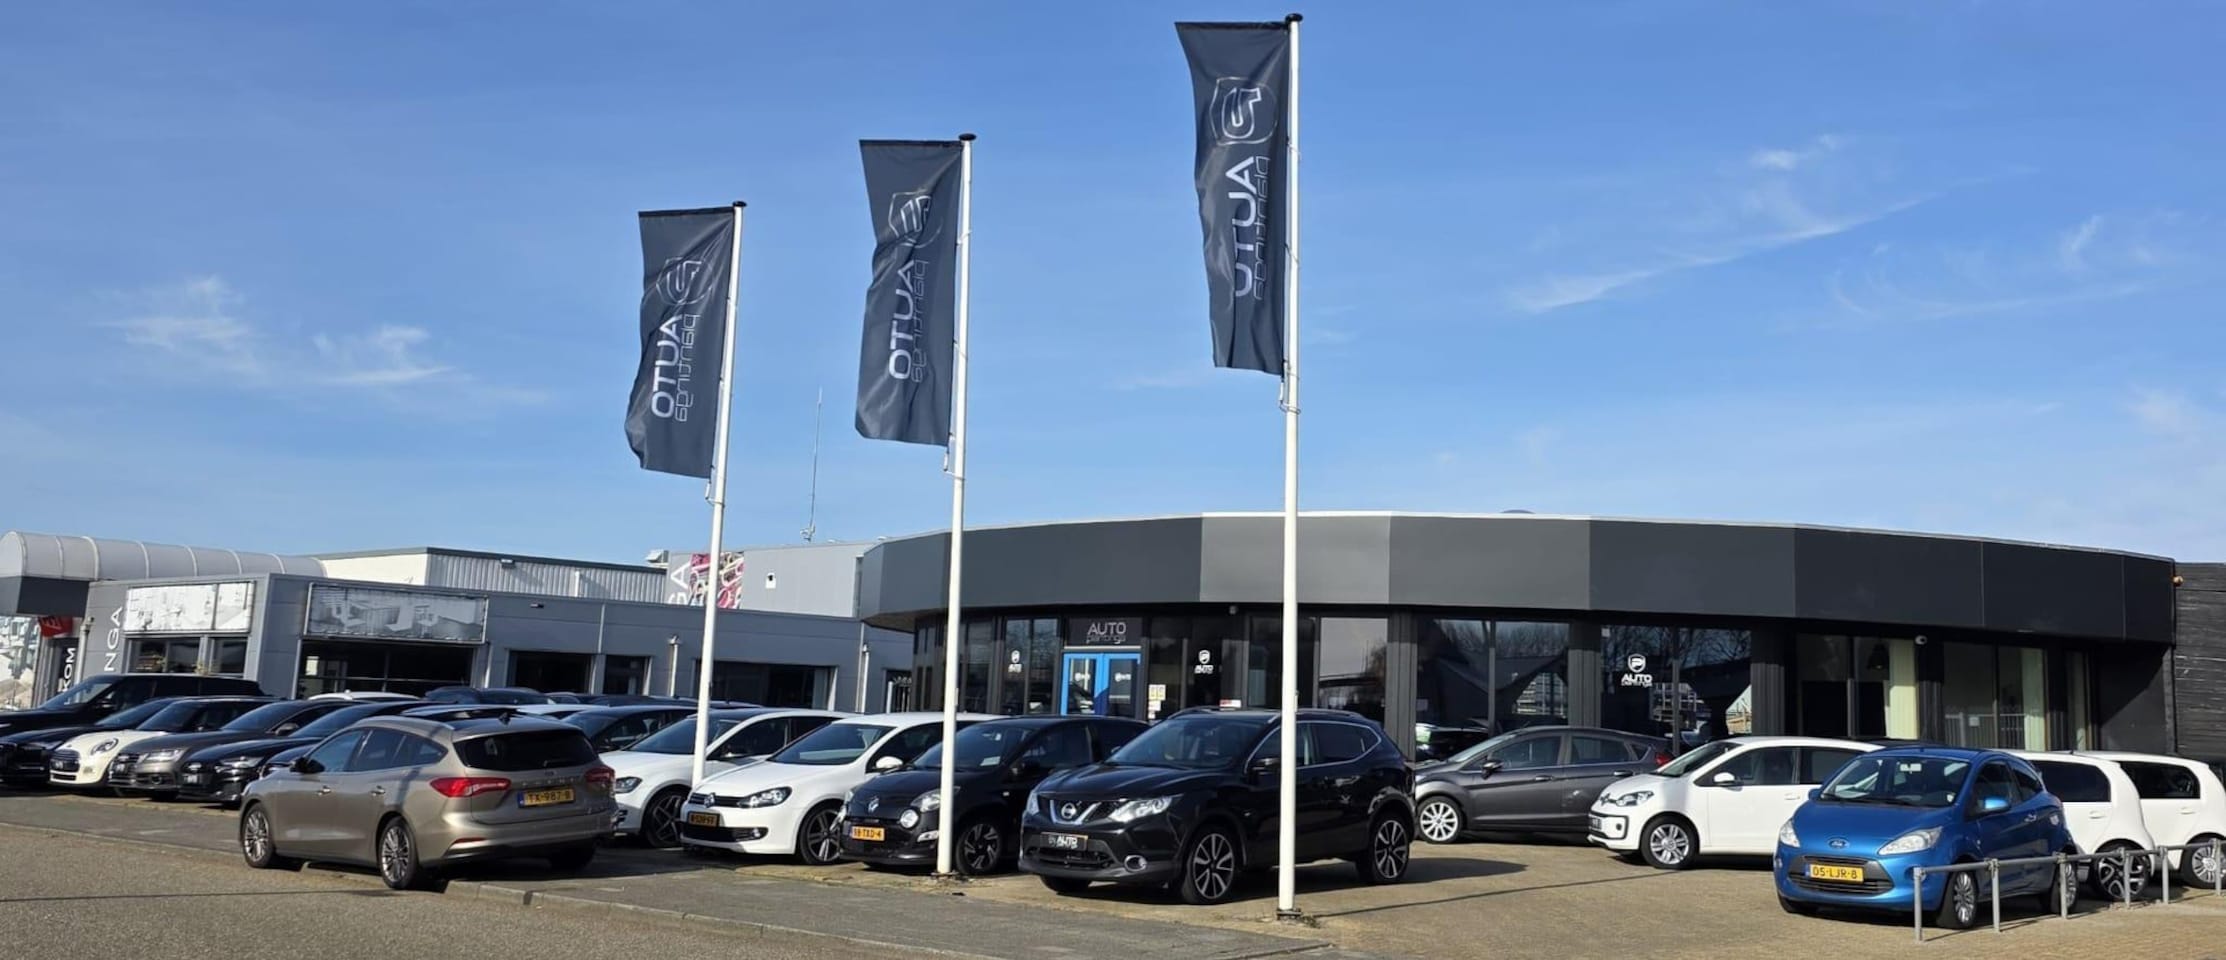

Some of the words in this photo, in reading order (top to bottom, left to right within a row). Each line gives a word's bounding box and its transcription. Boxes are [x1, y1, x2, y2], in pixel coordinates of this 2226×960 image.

[1087, 622, 1127, 635] AUTO
[103, 606, 122, 672] NGA
[1621, 673, 1653, 683] AUTO
[1812, 866, 1858, 879] 05-LJR-8
